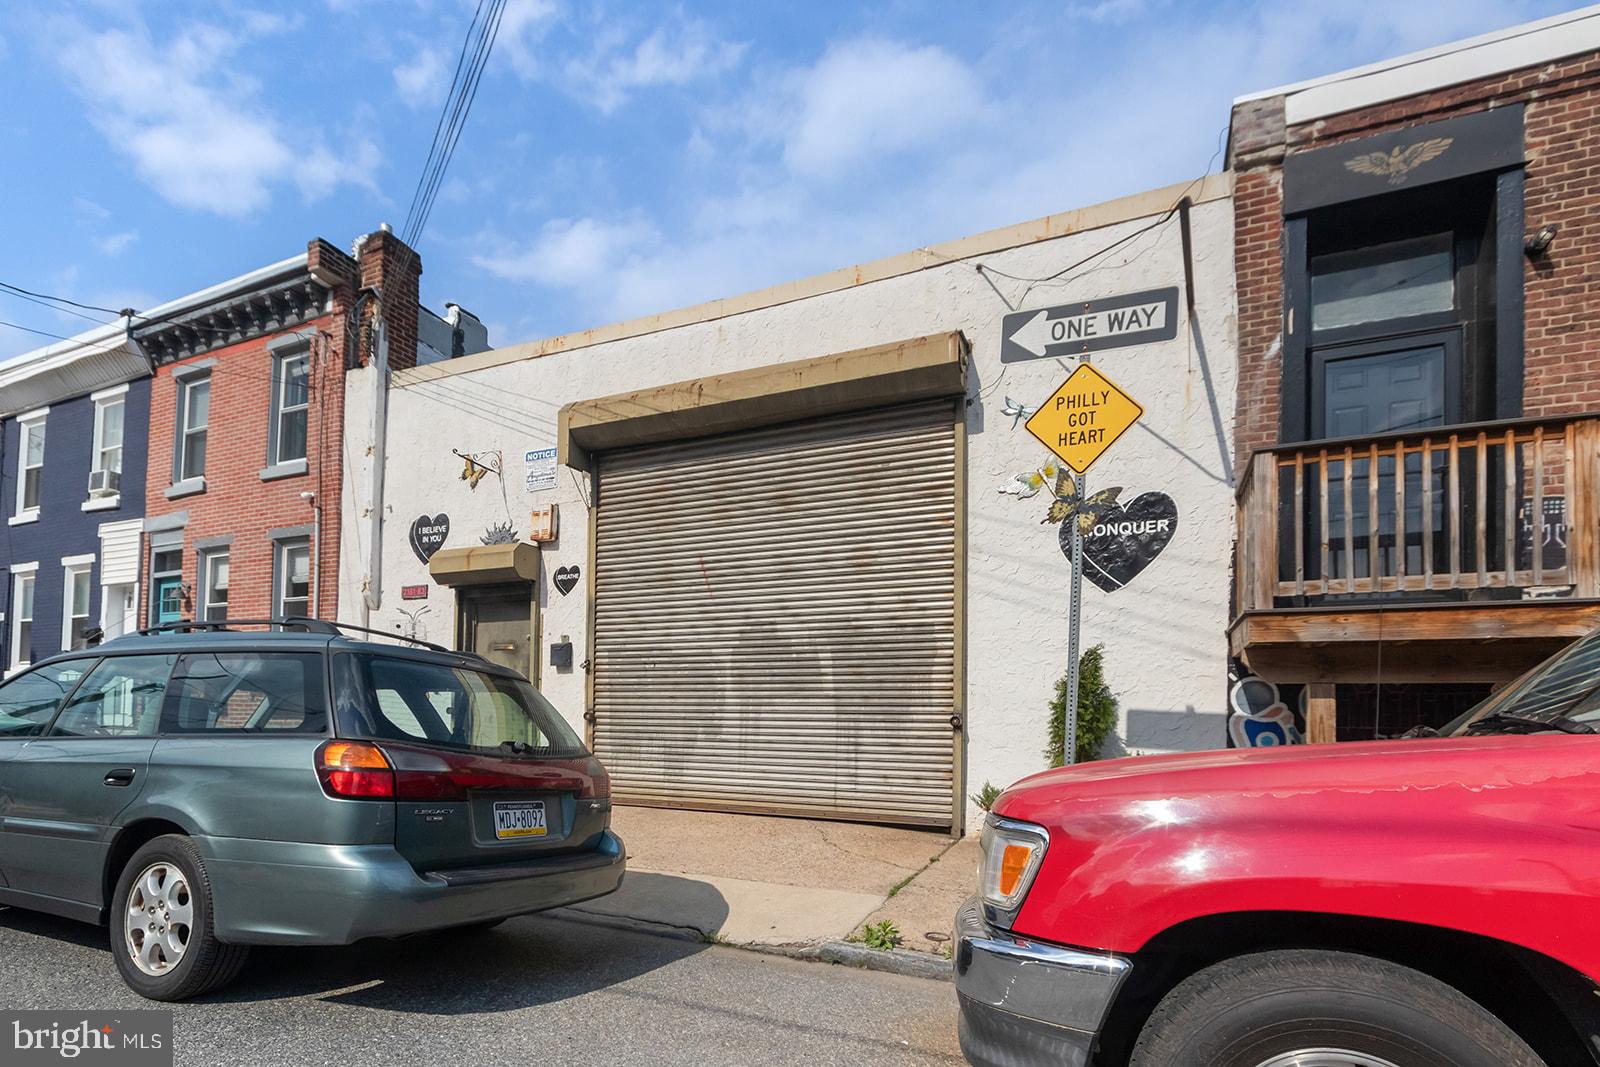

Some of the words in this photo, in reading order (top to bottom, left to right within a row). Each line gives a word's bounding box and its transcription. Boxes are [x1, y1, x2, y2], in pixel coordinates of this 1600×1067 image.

[1051, 316, 1097, 342] ONE
[1107, 305, 1159, 333] WAY
[1056, 390, 1110, 411] PHILLY
[1068, 411, 1097, 428] GOT
[1058, 428, 1105, 447] HEART
[527, 449, 556, 461] NOTICE
[418, 527, 421, 535] I
[422, 525, 447, 534] BELIEVE
[1084, 519, 1170, 538] ONQUER
